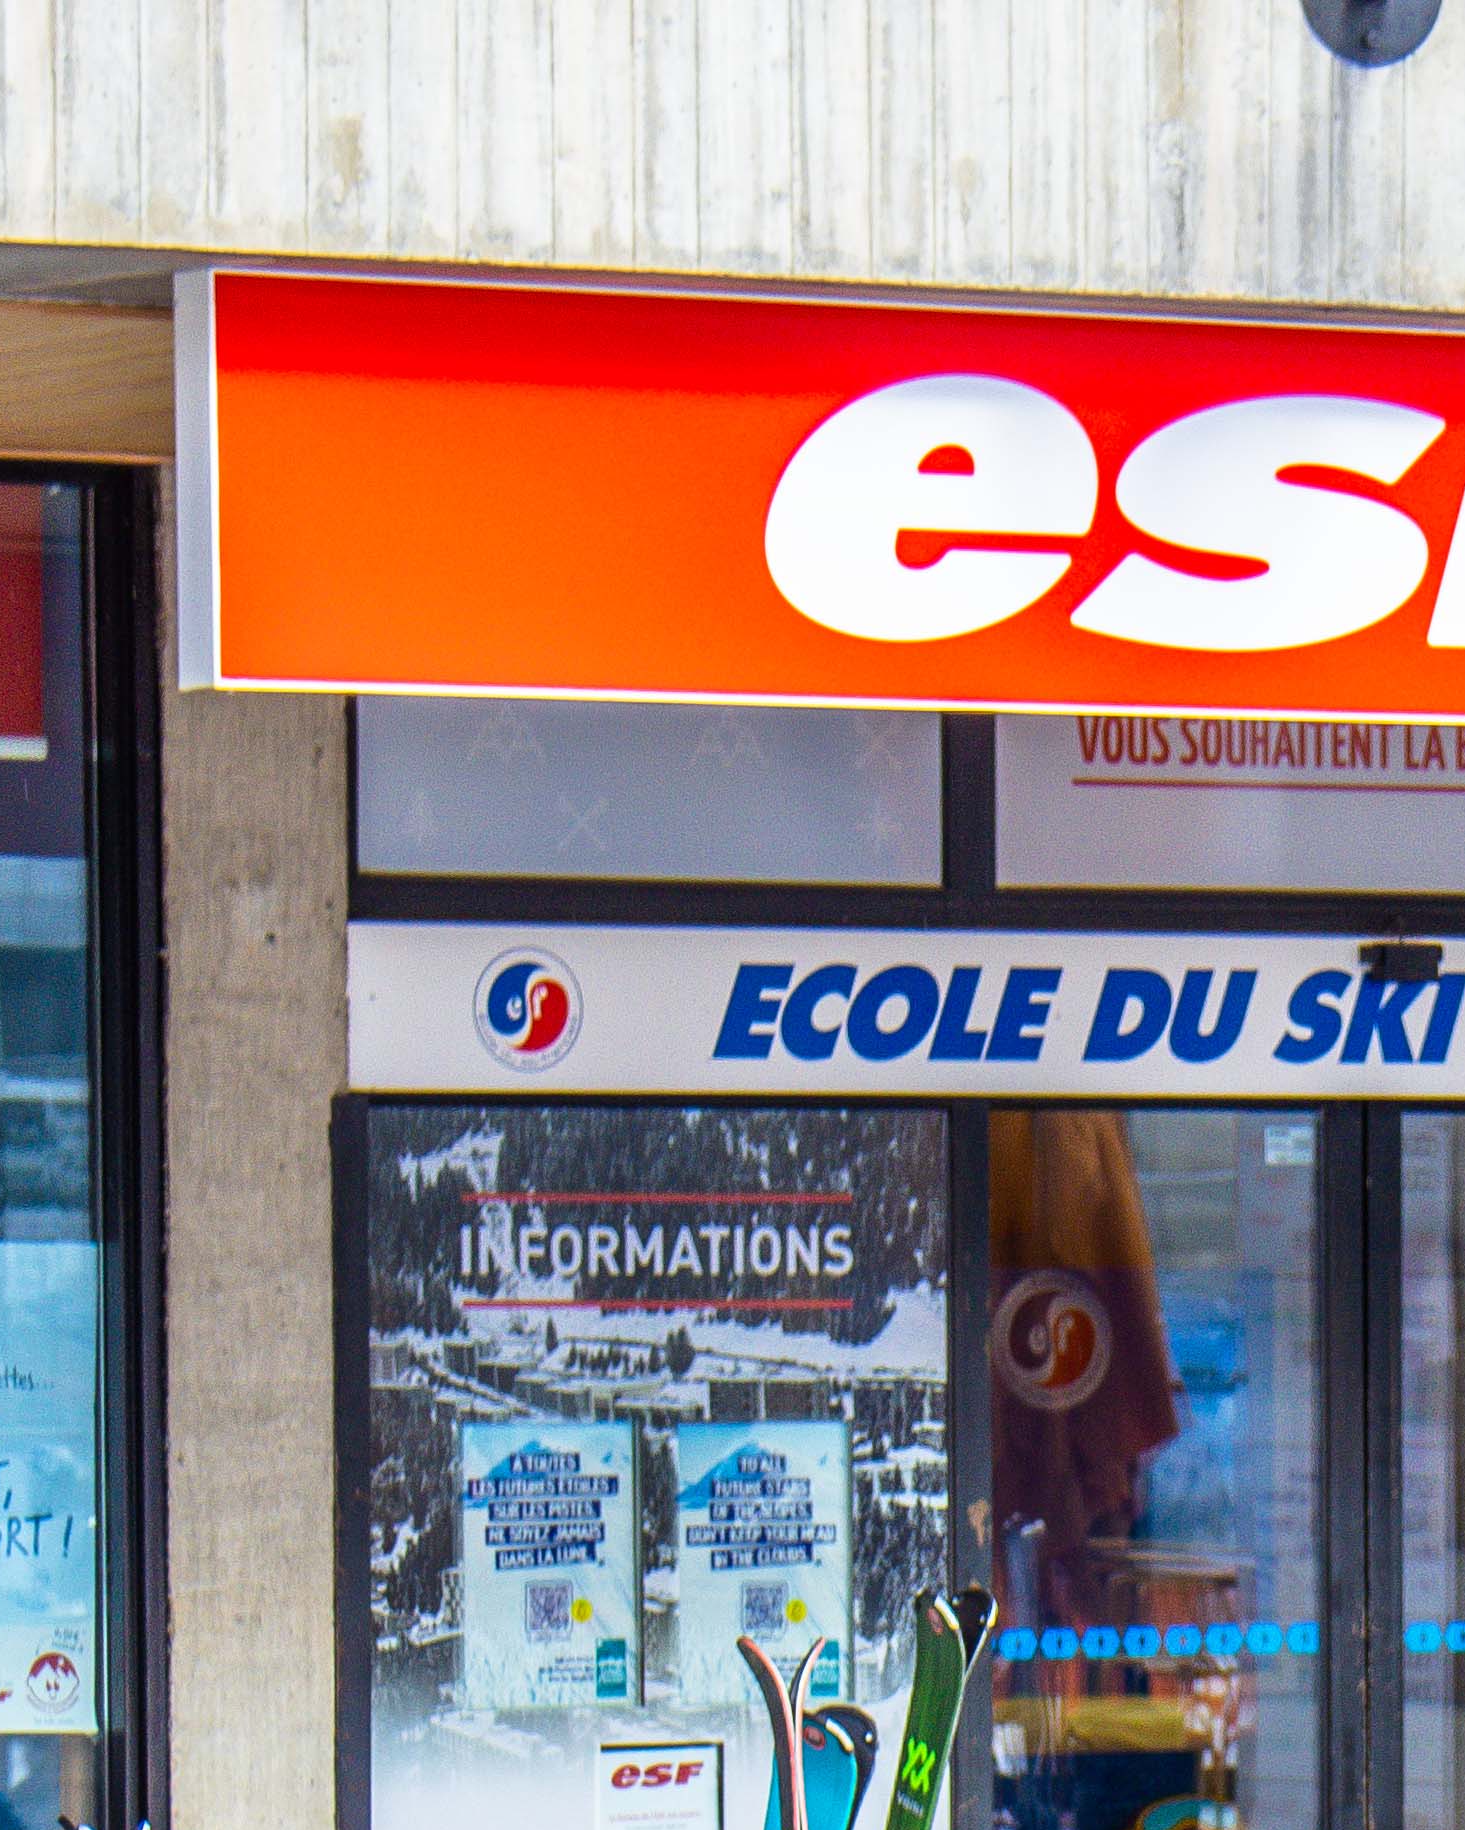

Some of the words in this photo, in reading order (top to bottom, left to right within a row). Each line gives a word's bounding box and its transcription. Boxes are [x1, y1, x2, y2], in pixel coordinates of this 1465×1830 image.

[1077, 715, 1171, 766] VOUS
[1181, 719, 1388, 769] SOUHAITENT
[1404, 724, 1446, 771] LA
[713, 963, 1063, 1062] ECOLE
[1082, 967, 1257, 1064] DU
[461, 1224, 855, 1277] INFORMATIONS
